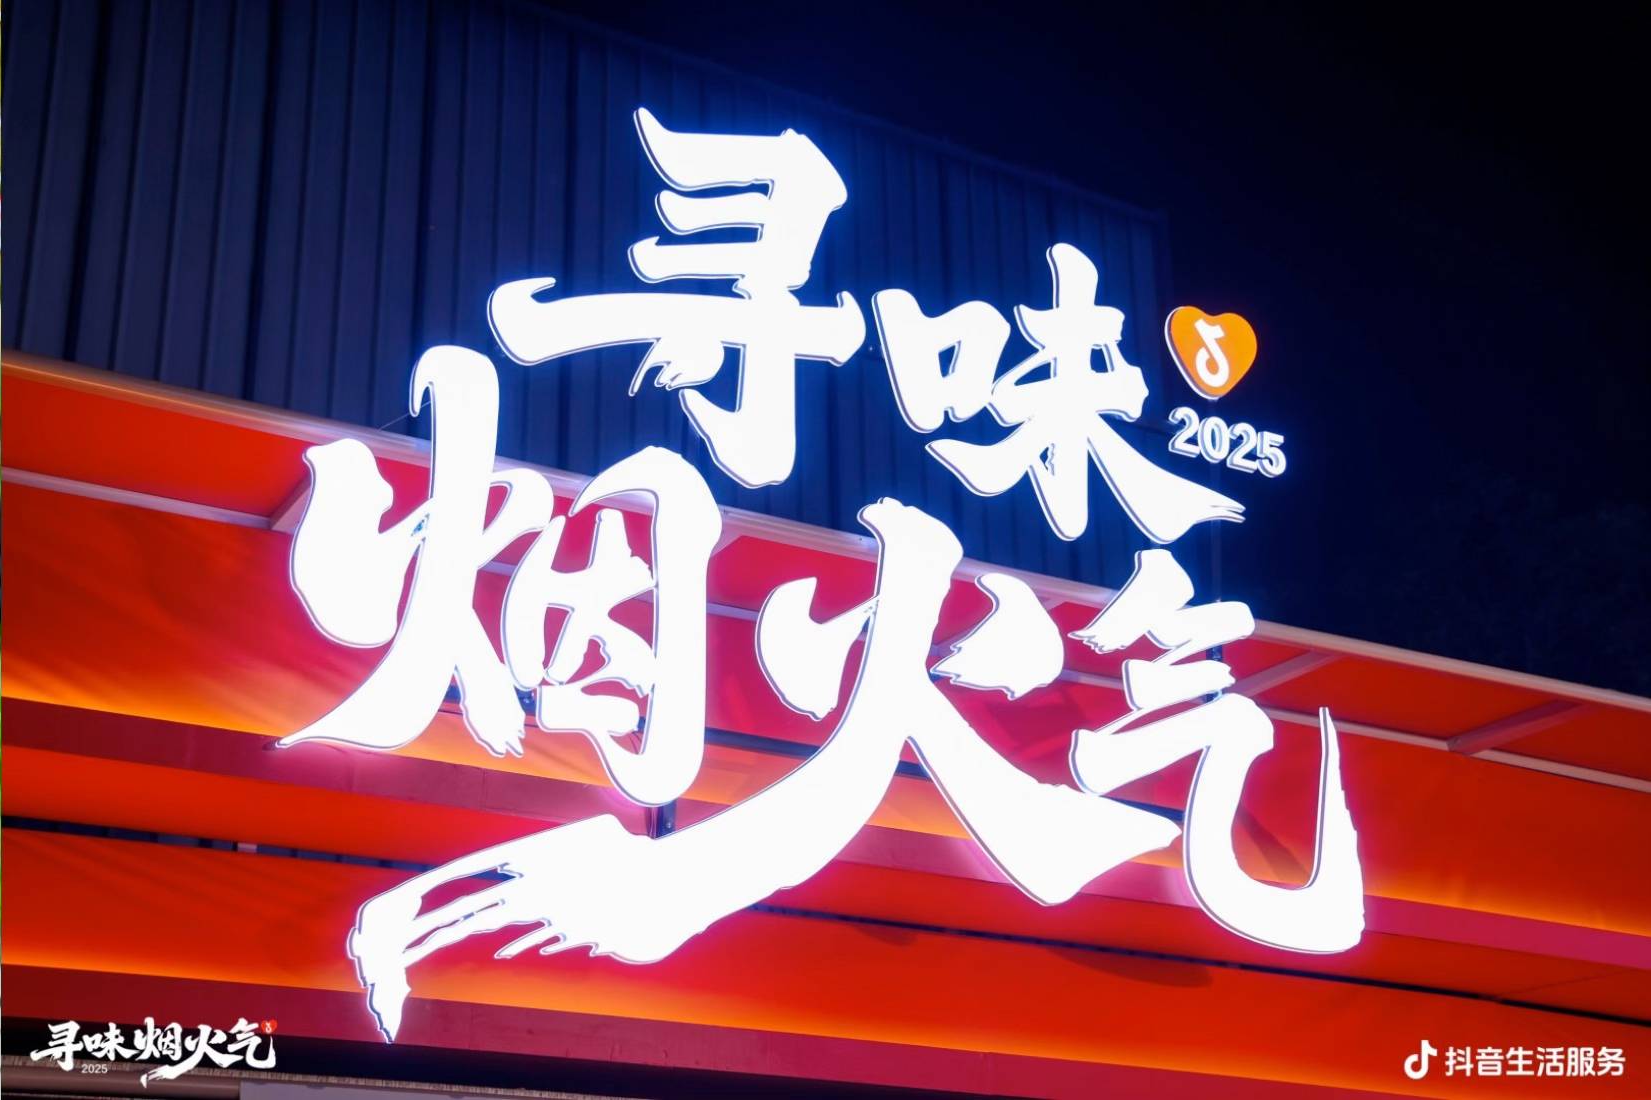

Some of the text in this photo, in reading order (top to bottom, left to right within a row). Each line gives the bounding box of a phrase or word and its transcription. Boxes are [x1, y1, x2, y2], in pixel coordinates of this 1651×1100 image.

[487, 106, 1245, 542] 寻味
[1166, 405, 1288, 478] 2025
[265, 345, 1365, 1043] 烟火气
